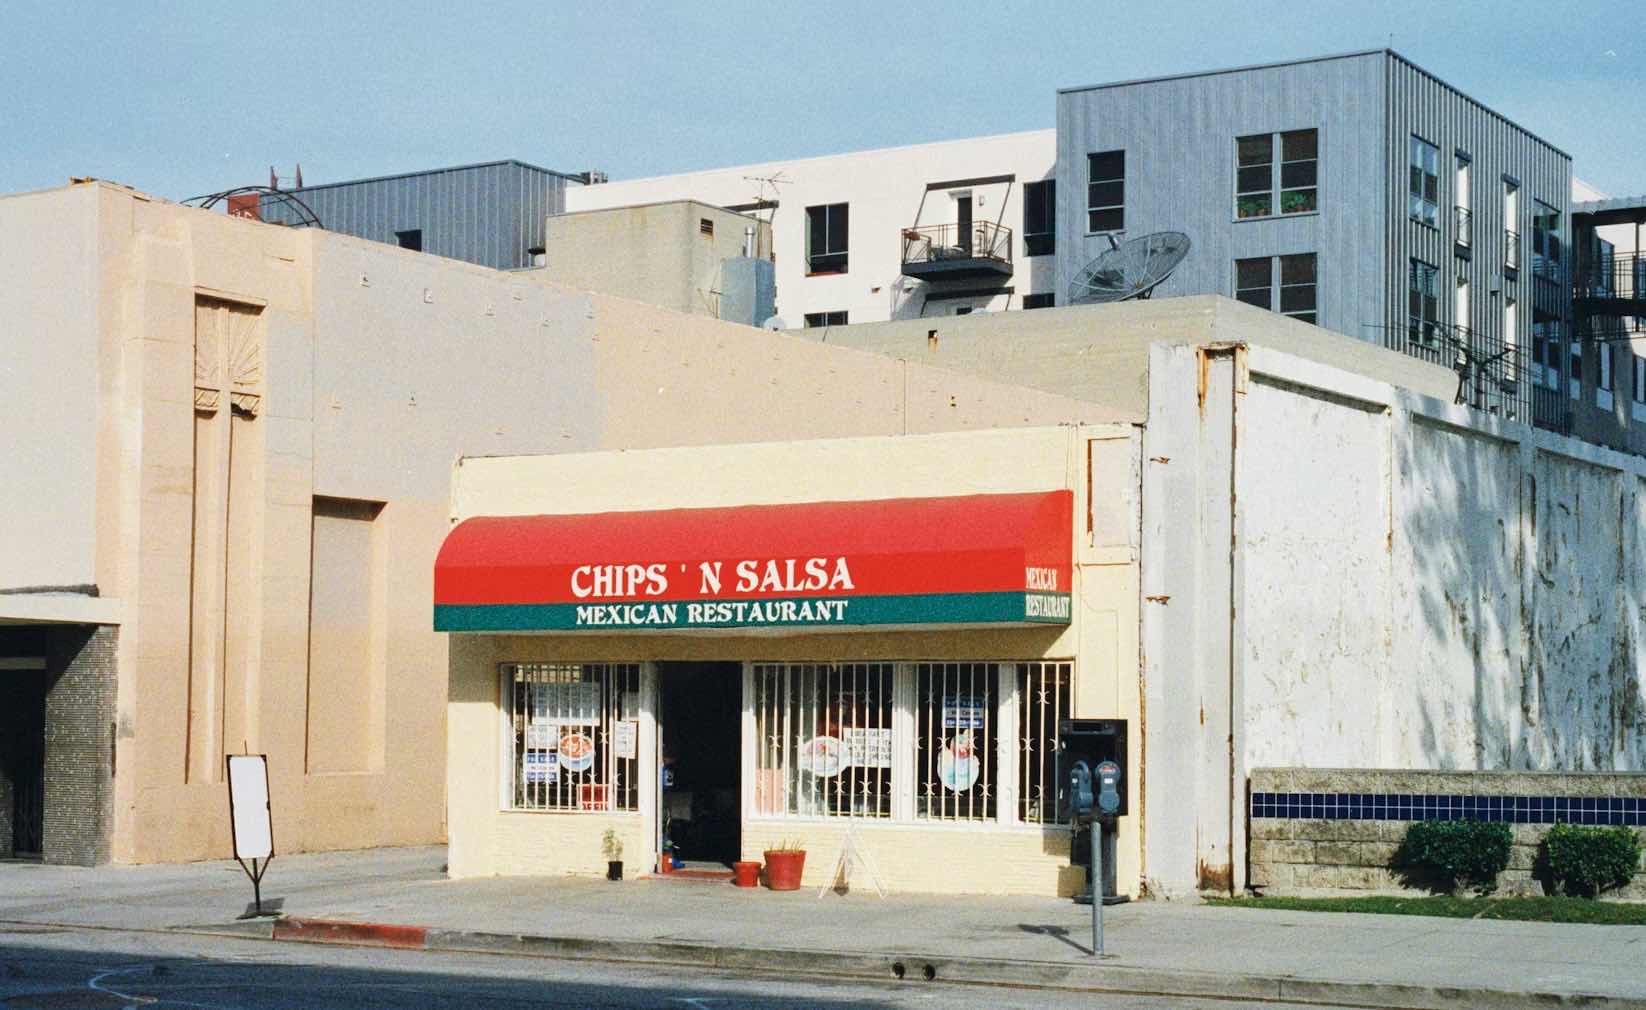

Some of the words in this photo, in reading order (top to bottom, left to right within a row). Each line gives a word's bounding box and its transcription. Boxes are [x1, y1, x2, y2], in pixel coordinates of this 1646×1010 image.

[571, 564, 668, 598] CHIPS
[736, 557, 855, 593] SALSA
[1025, 567, 1057, 591] MEXICAN
[576, 603, 678, 625] MEXICAN
[687, 600, 849, 624] RESTAURANT
[1025, 594, 1070, 619] RESTAURANT
